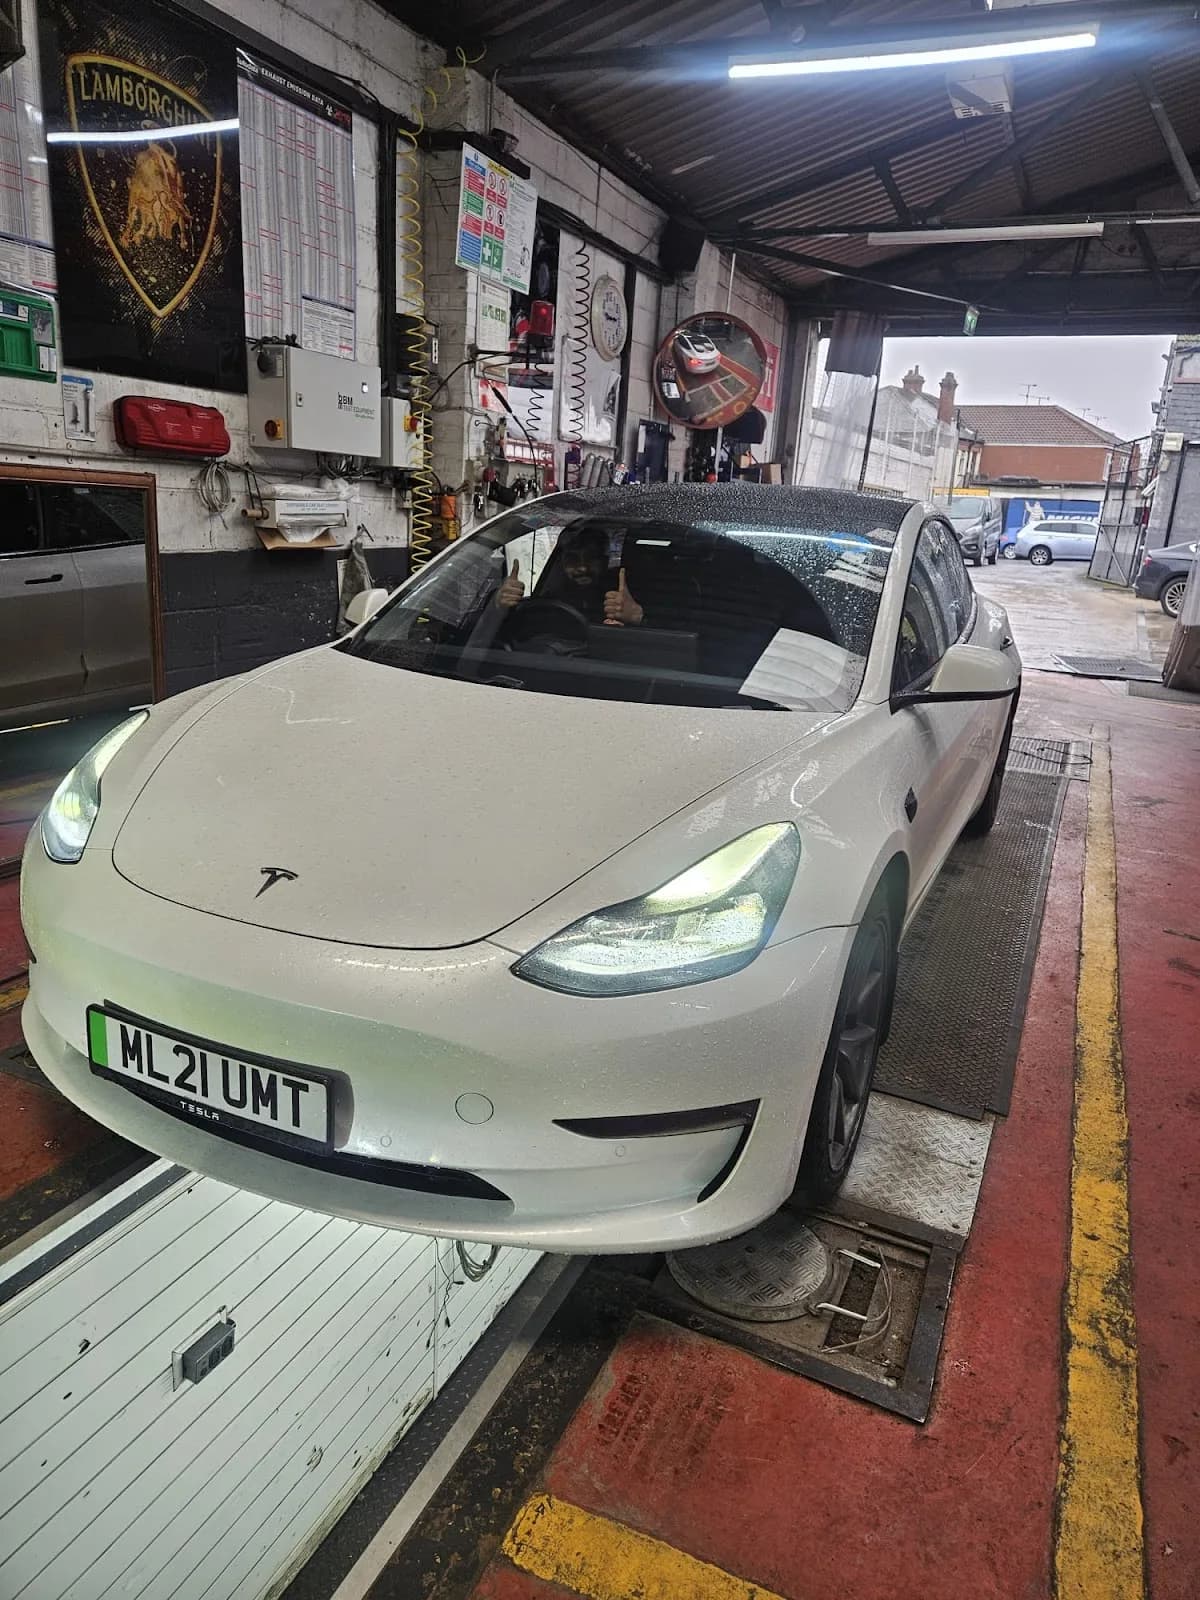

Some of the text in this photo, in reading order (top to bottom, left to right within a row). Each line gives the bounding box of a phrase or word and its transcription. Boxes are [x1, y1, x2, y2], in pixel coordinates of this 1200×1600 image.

[120, 1023, 310, 1129] ML21 UMT
[180, 1100, 220, 1121] TESLA
